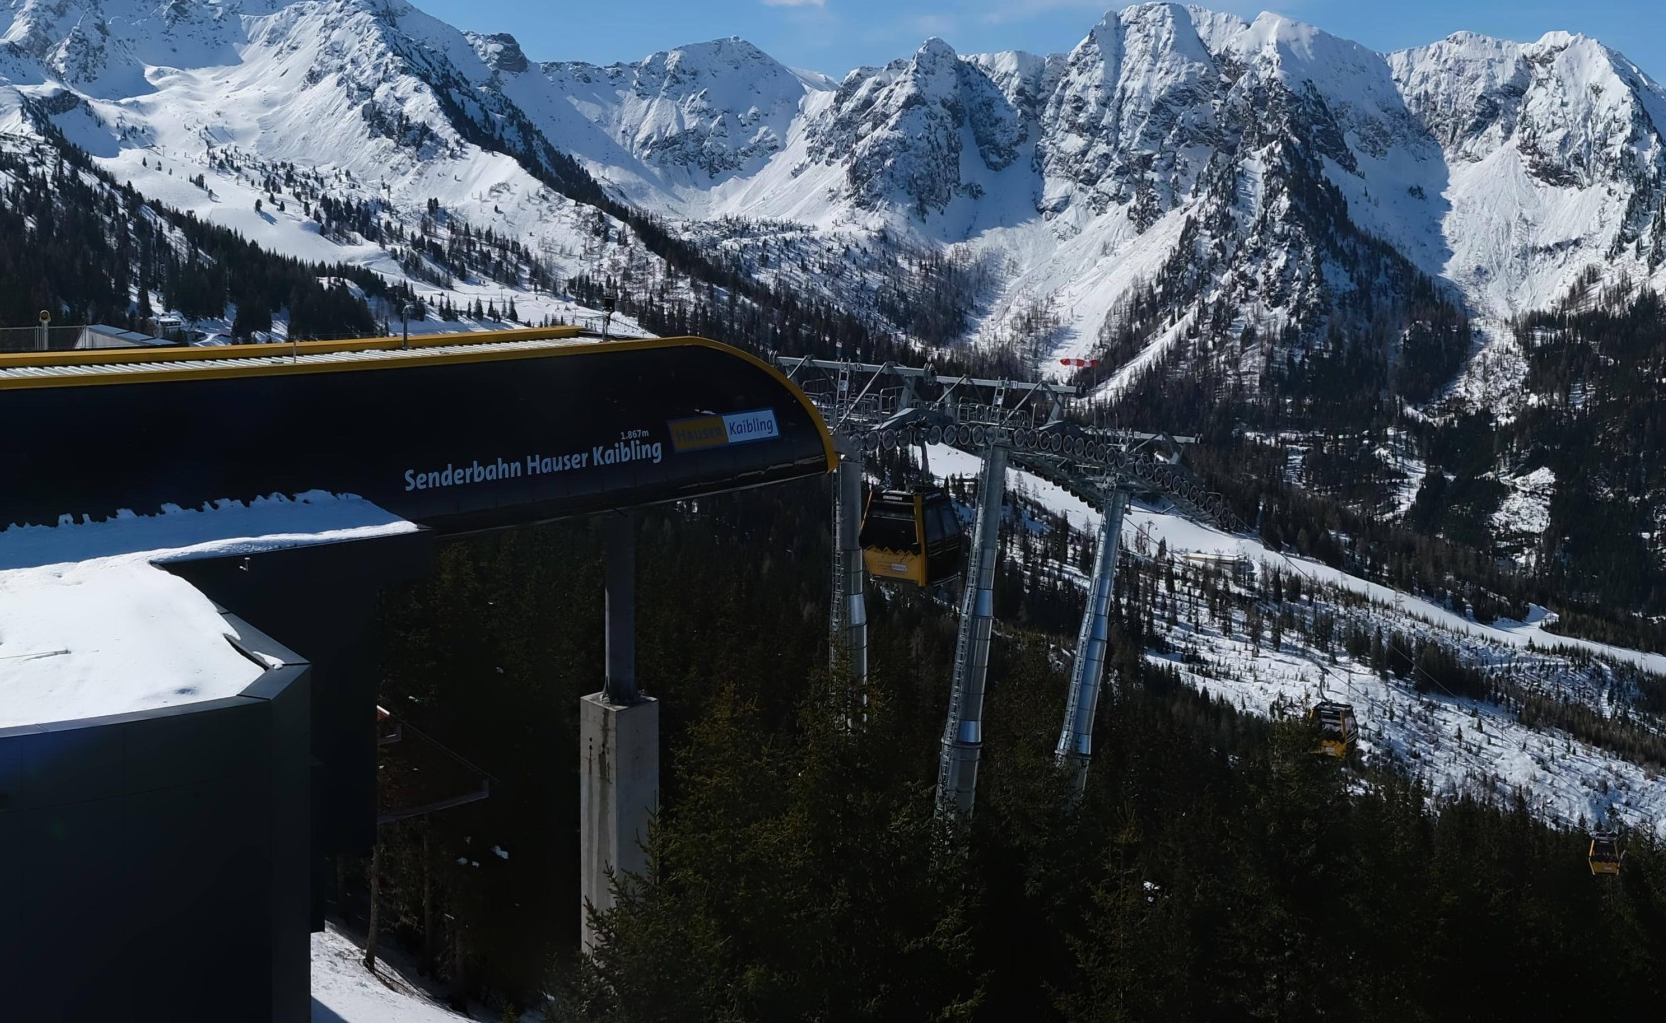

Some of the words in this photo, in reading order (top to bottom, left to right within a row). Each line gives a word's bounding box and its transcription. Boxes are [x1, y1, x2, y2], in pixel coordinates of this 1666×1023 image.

[620, 429, 650, 440] 1.867m
[729, 418, 774, 436] Kaibling
[404, 457, 522, 491] Senderbahn
[526, 451, 588, 475] Hauser
[592, 440, 663, 466] Kaibling
